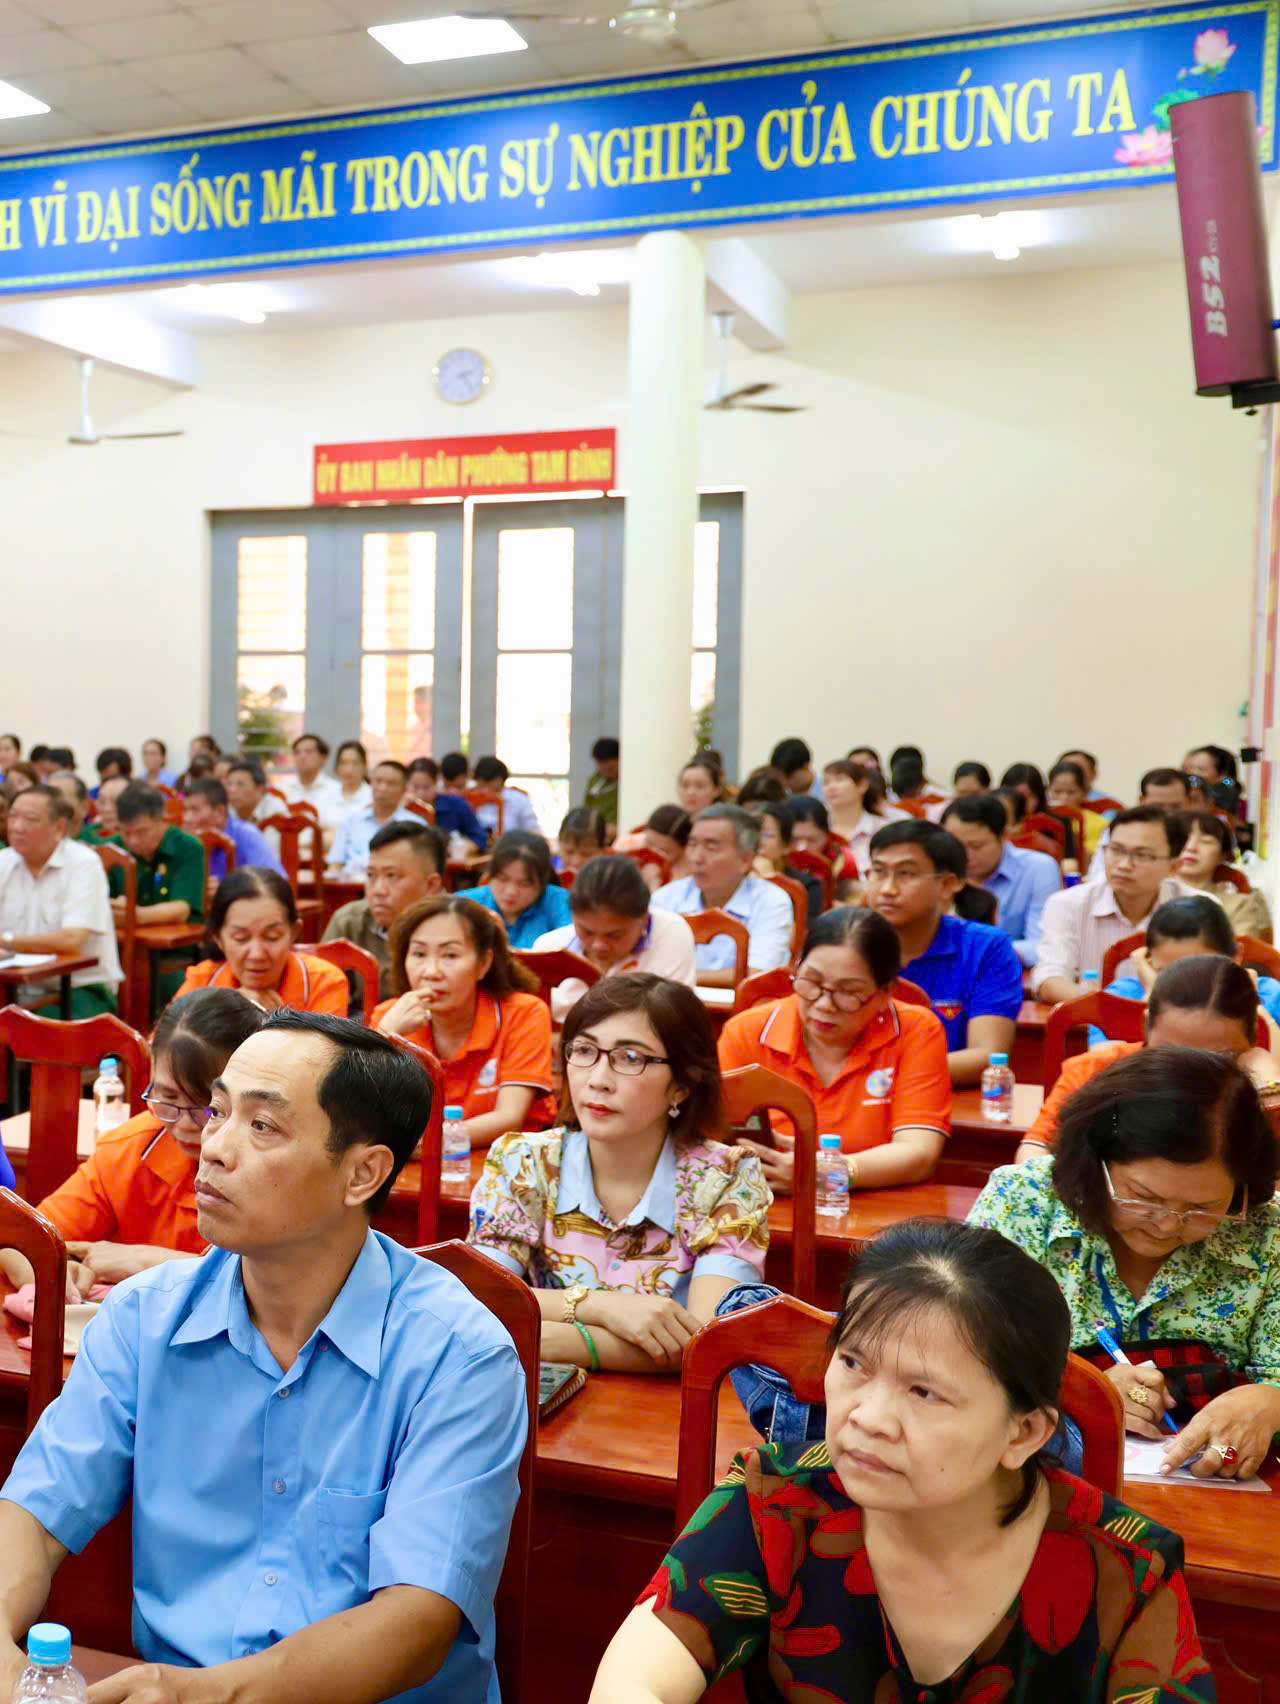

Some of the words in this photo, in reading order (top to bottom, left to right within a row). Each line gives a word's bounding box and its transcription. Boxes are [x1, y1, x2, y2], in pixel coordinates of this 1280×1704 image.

[30, 180, 68, 248] VĨ
[75, 185, 141, 253] ĐẠI
[150, 152, 252, 236] SỐNG
[260, 150, 337, 224] MÃI
[346, 144, 489, 214] TRONG
[500, 122, 560, 209] SỰ
[567, 101, 746, 194] NGHIỆP
[756, 80, 857, 171] CỦA
[869, 67, 1054, 159] CHÚNG
[1067, 68, 1137, 137] TA
